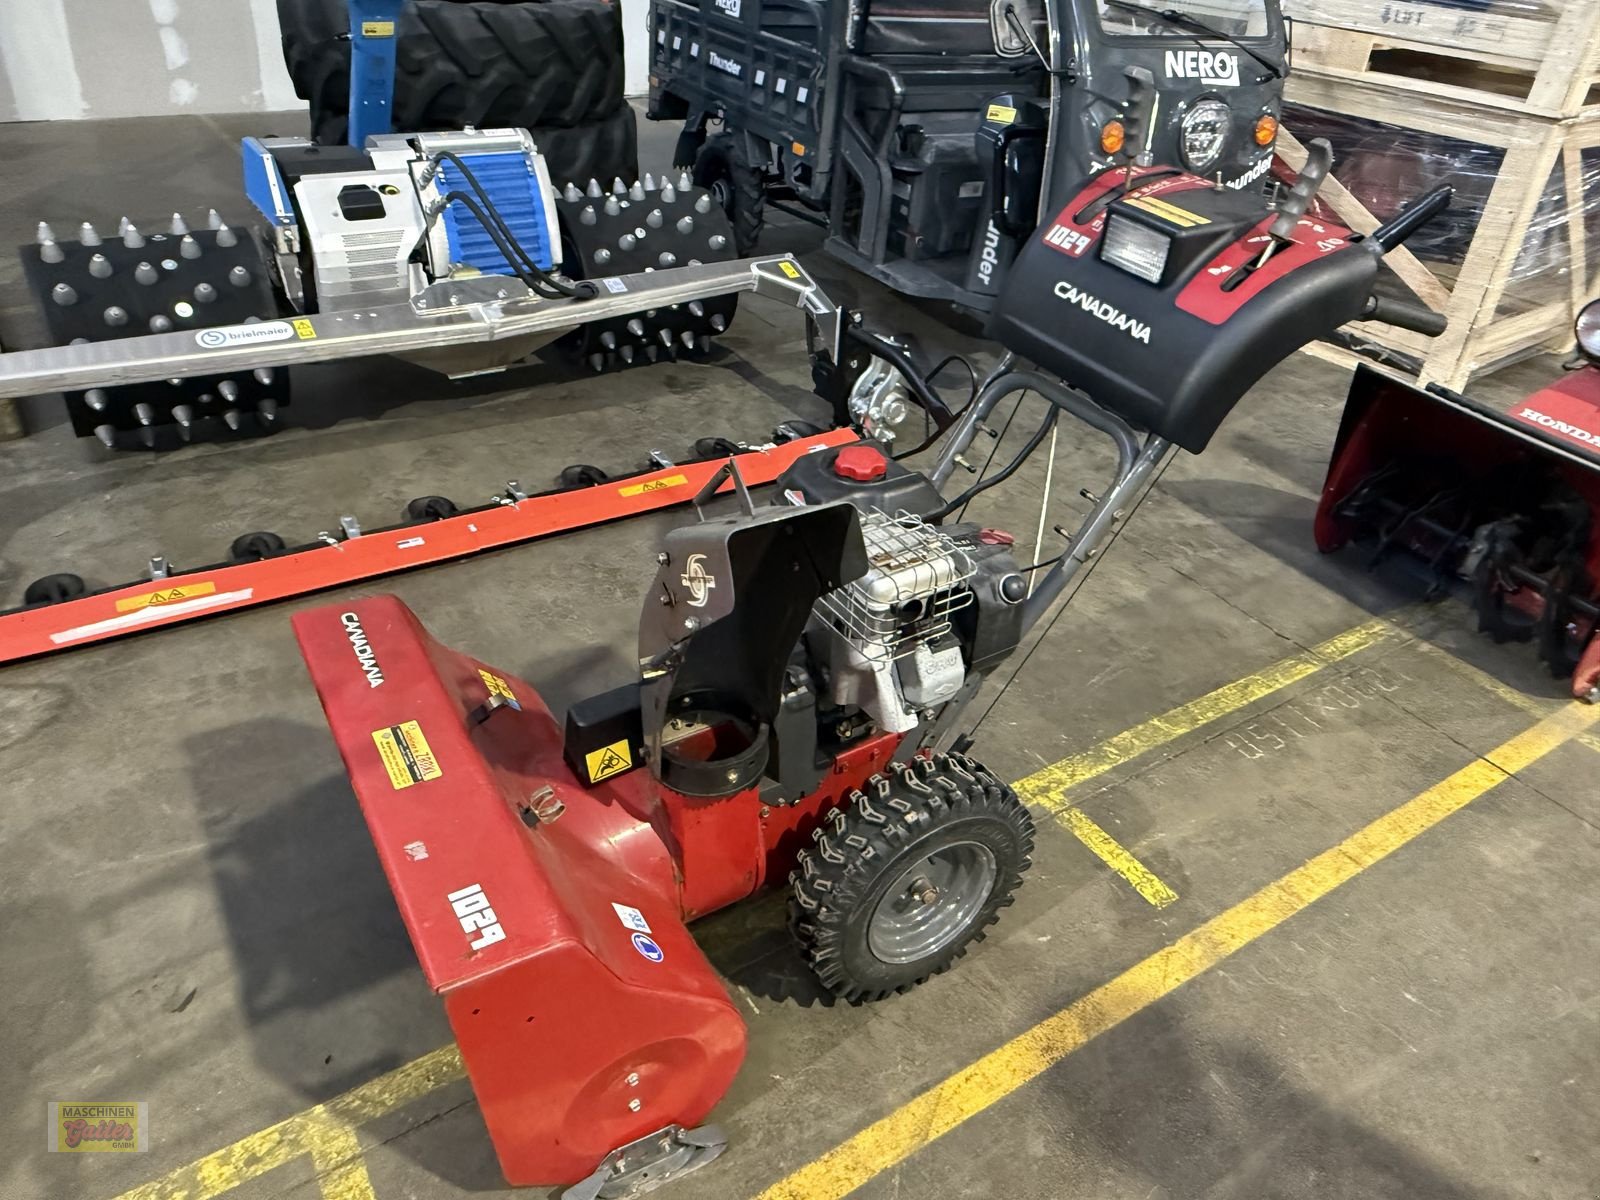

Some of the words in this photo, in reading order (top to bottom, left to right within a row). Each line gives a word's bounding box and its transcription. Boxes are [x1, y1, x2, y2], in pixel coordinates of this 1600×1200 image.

[709, 51, 742, 76] Thunder
[1165, 50, 1238, 84] NERO
[1044, 224, 1092, 255] 1029
[1054, 281, 1151, 344] CANADIANA
[228, 327, 289, 341] brielmaier
[340, 612, 385, 689] CANADIANA
[447, 883, 507, 951] 1029
